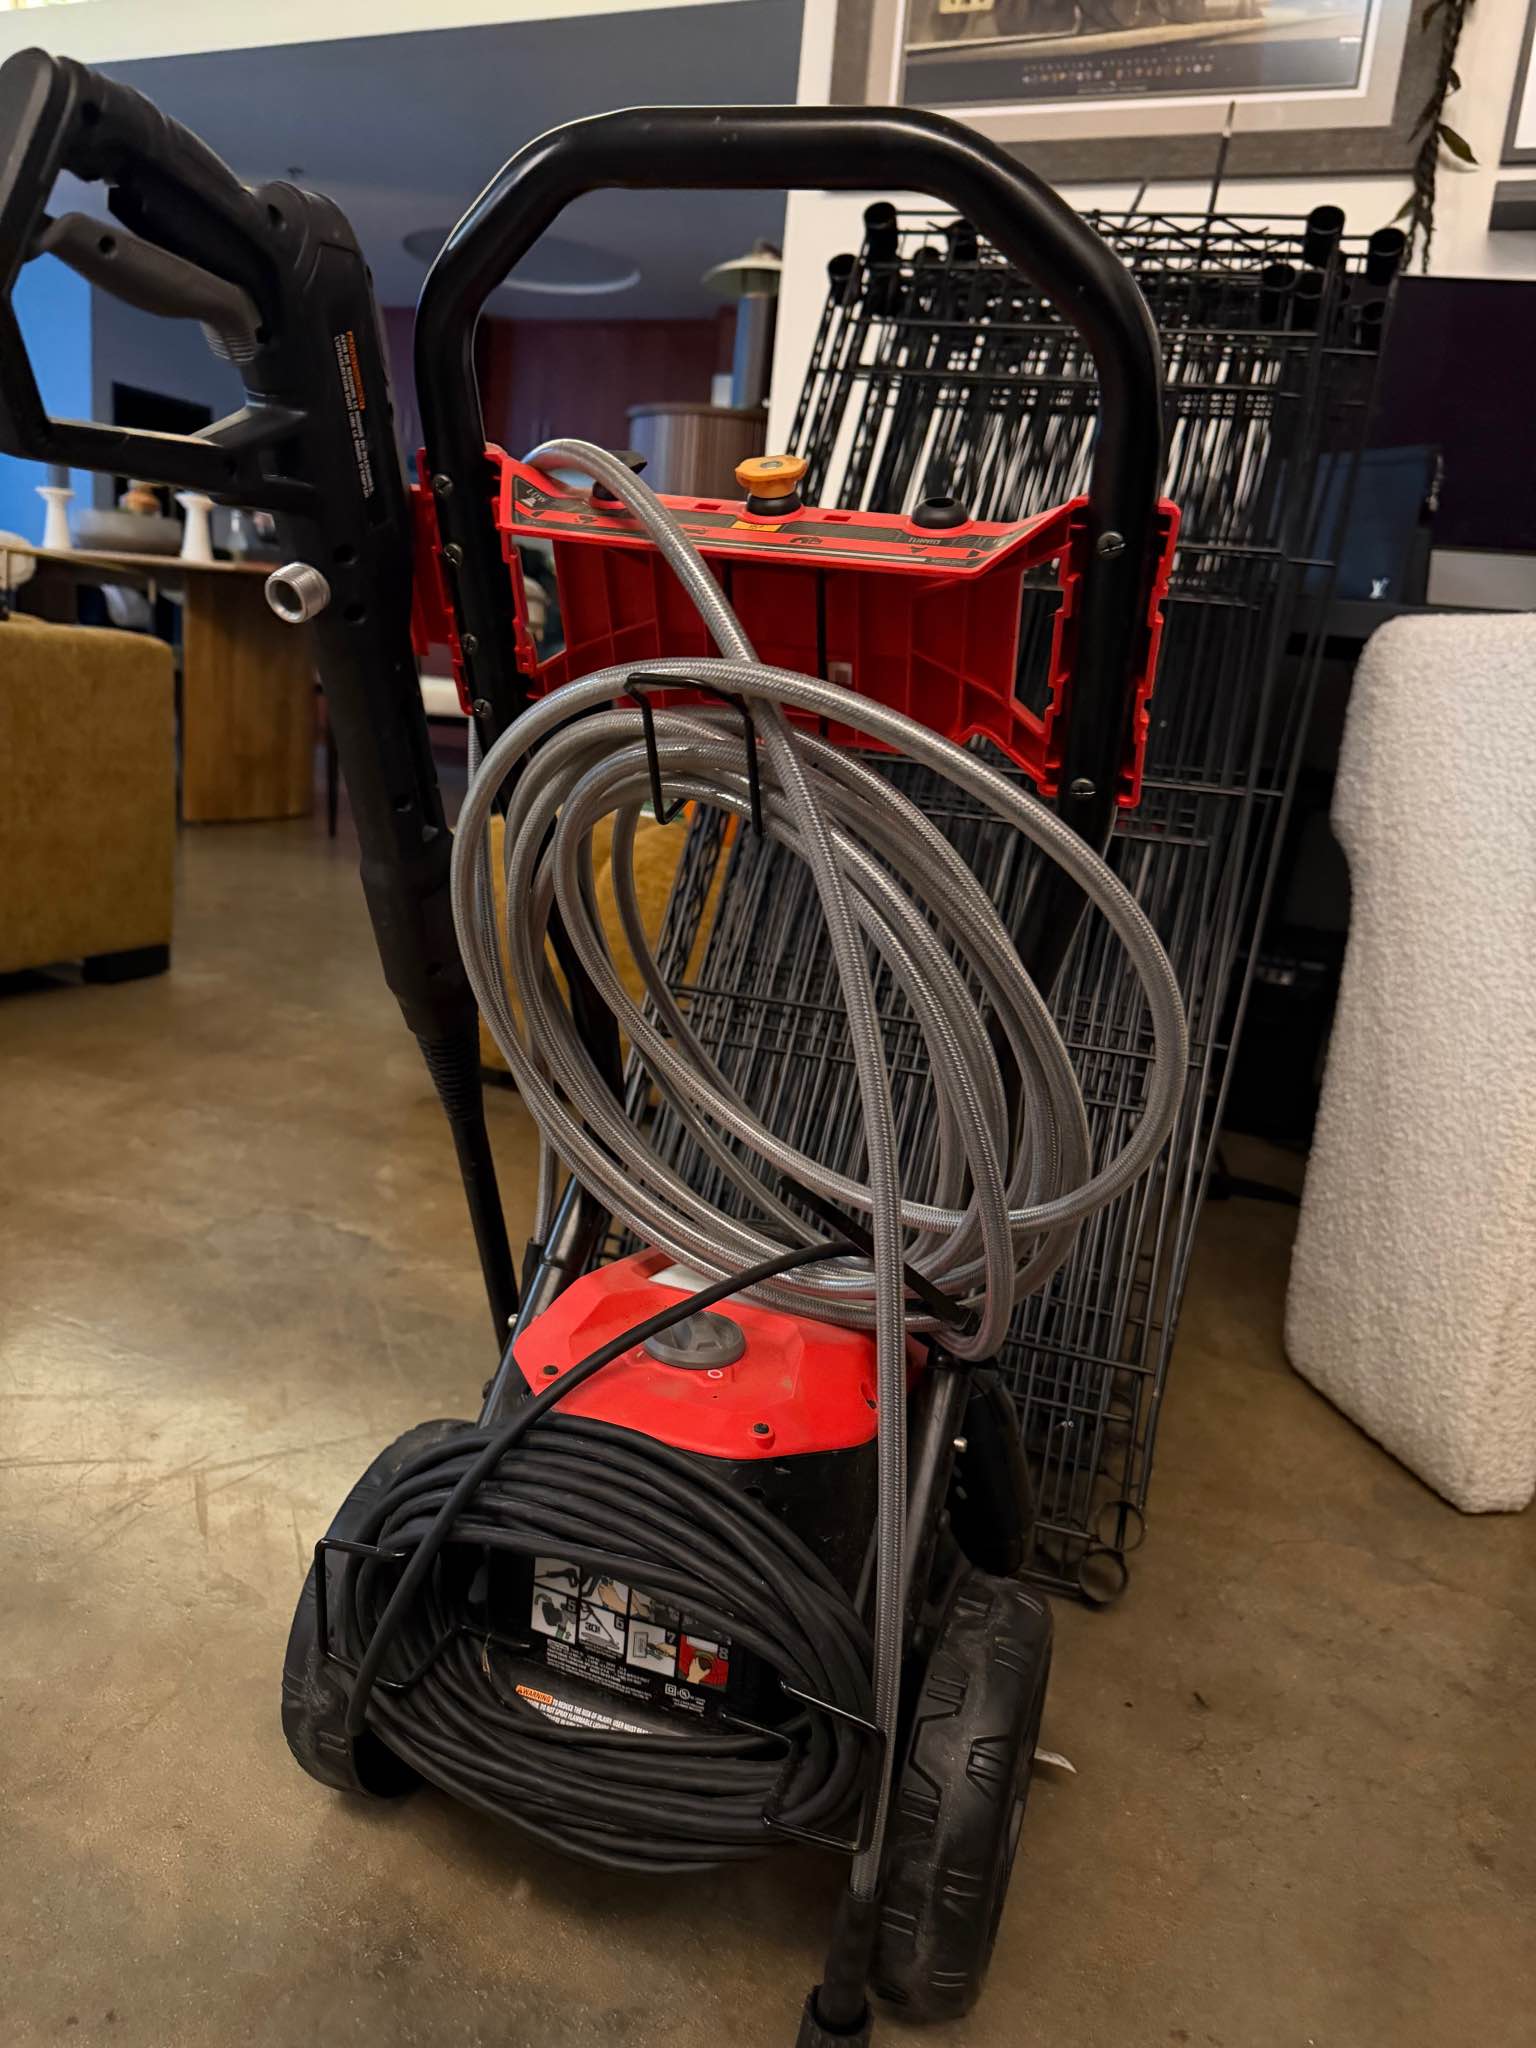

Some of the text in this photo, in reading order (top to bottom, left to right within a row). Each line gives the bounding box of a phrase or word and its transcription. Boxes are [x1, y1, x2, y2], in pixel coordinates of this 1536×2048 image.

[908, 537, 941, 545] TURBO
[615, 1617, 625, 1629] 6
[667, 1632, 676, 1644] 7
[719, 1647, 729, 1660] 8
[522, 1687, 552, 1703] WARNING
[558, 1700, 574, 1712] REDUCE
[581, 1708, 592, 1718] RISK
[612, 1719, 625, 1729] USER
[624, 1723, 637, 1733] MUST
[555, 1708, 568, 1719] SPRAY
[567, 1713, 593, 1728] FLAMMABLE
